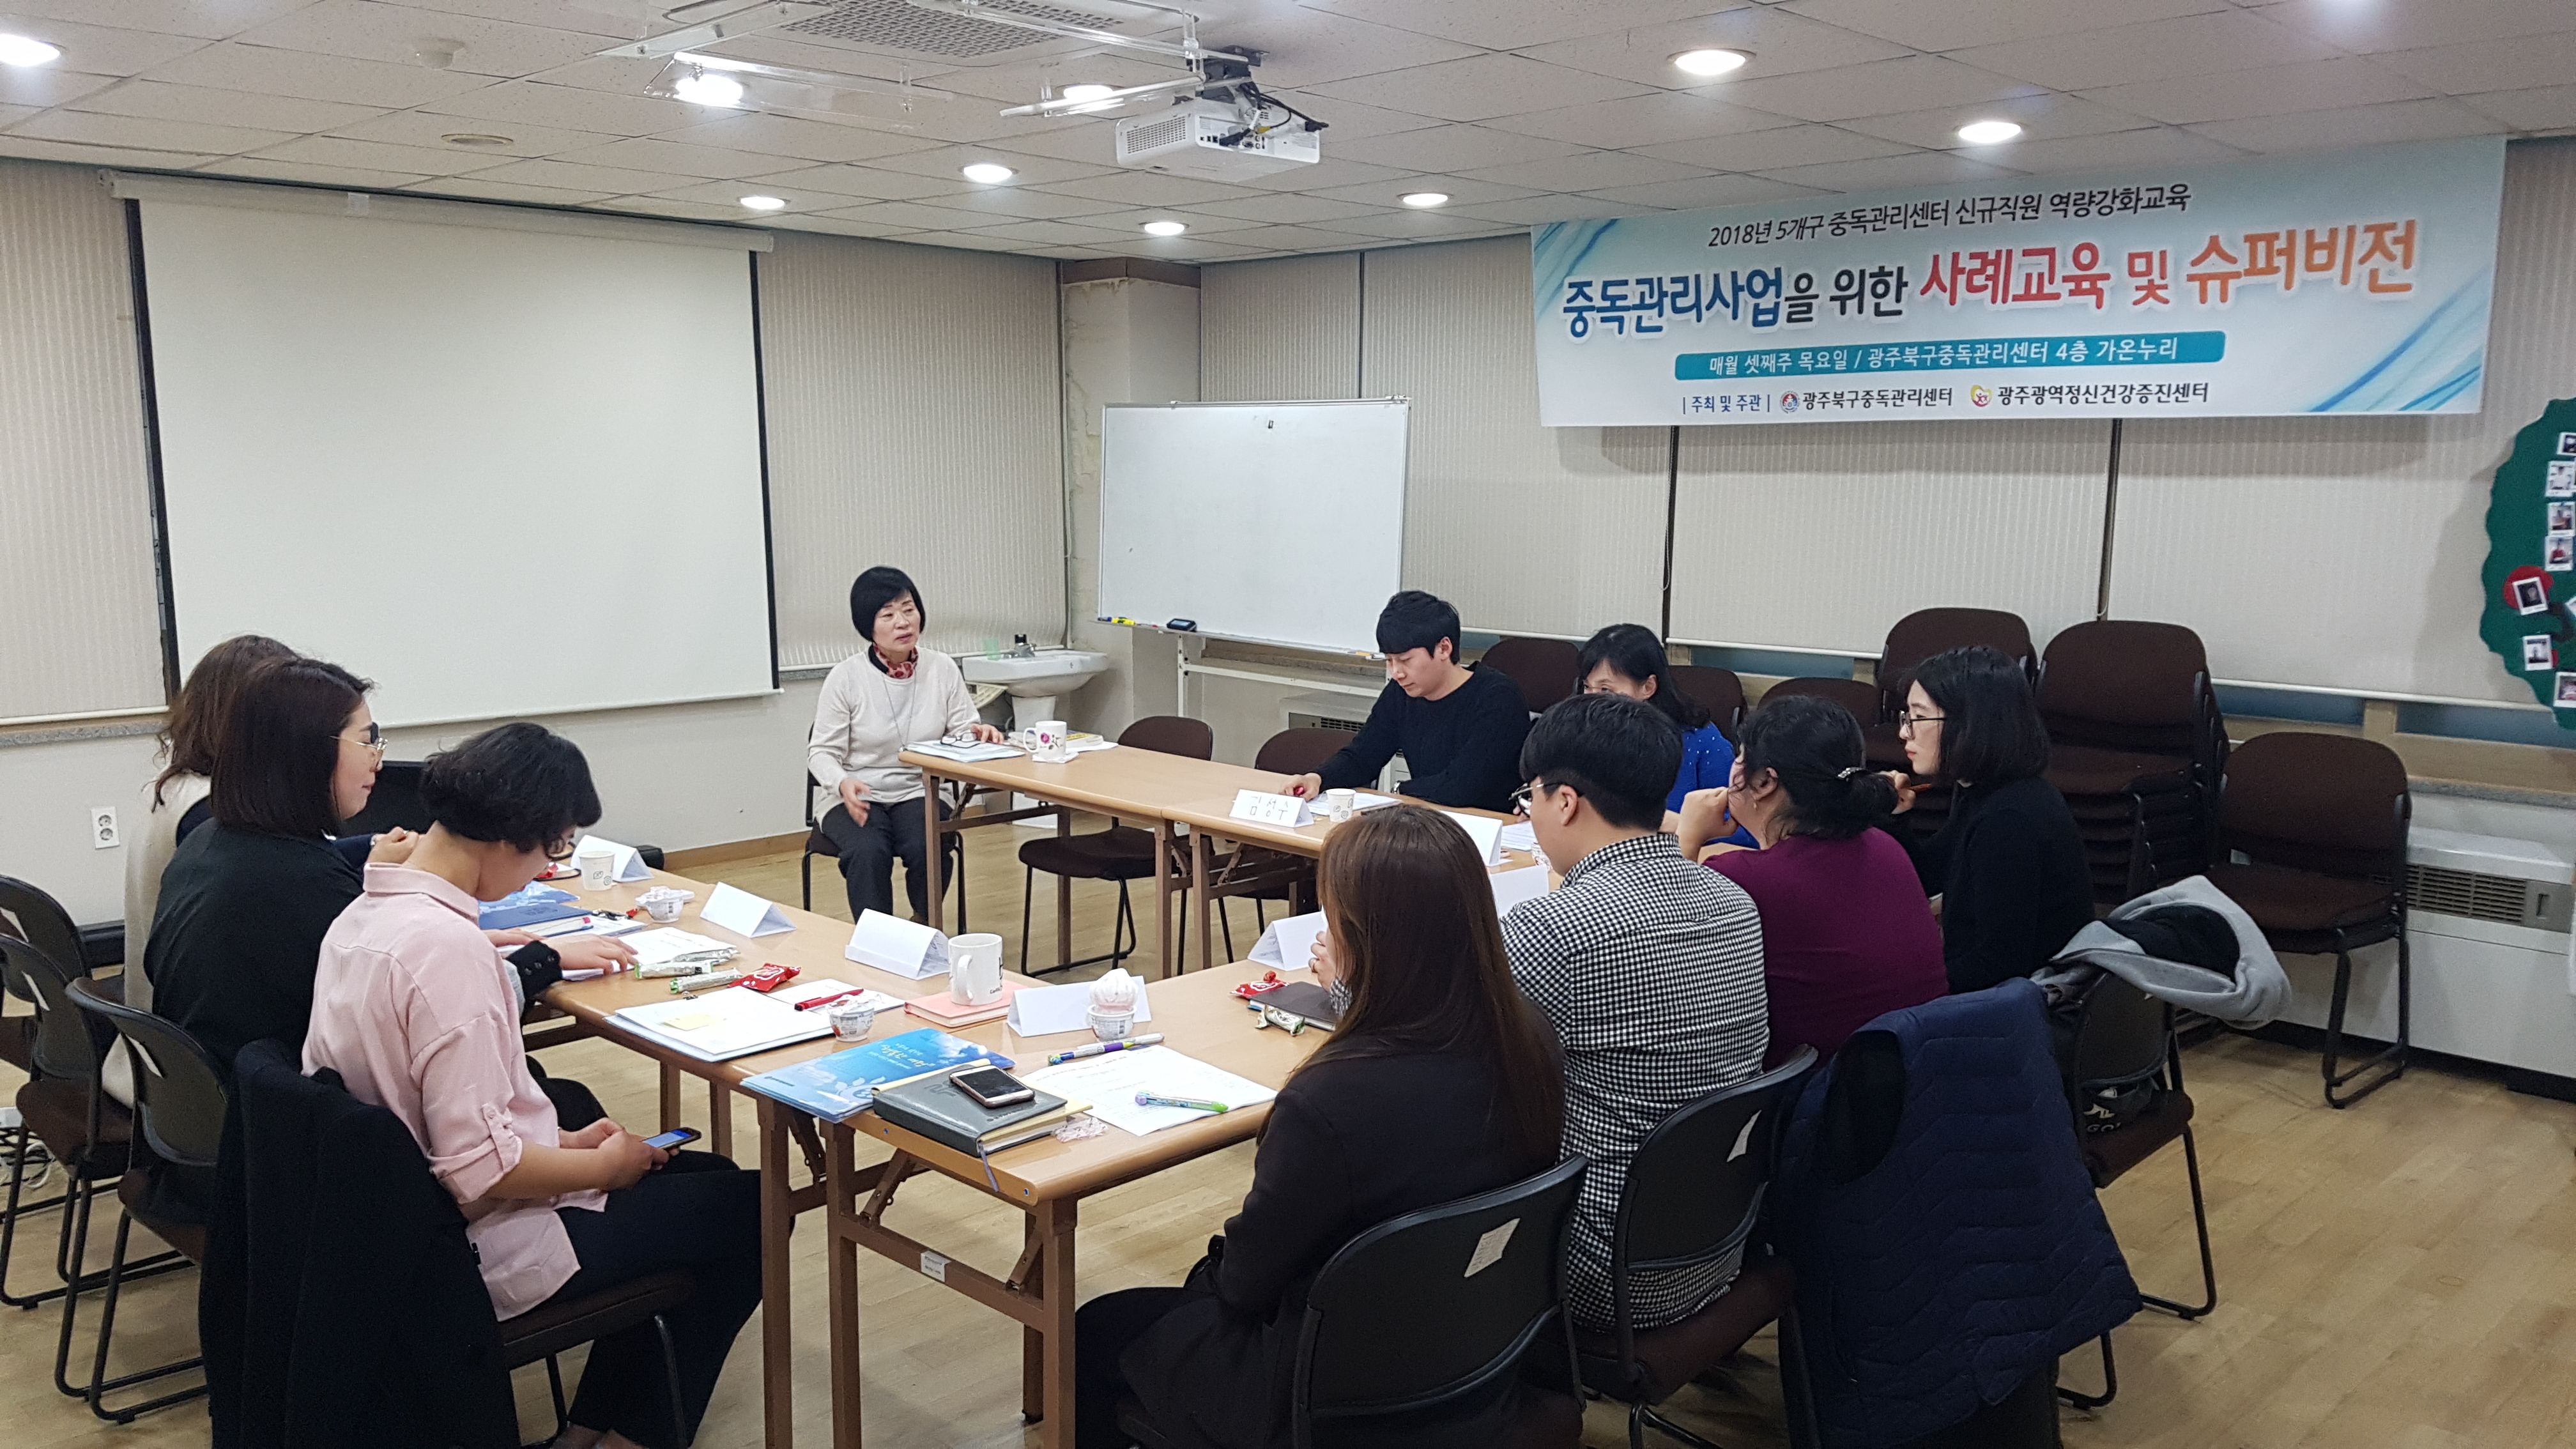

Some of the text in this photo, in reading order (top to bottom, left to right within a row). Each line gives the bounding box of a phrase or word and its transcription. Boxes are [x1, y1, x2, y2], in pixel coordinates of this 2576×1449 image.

[1708, 183, 2192, 247] 2018년 5개구 중독관리센터 신규직원 역량강화교육
[1563, 220, 2416, 338] 중독관리사업을 위한 사례교육 및 슈퍼비전
[1710, 355, 1738, 376] 매월
[1744, 353, 1793, 374] 셋째주
[1797, 349, 1848, 371] 목요일
[1867, 342, 2048, 369] 광주북구중독관리센터
[2055, 340, 2089, 362] 4층
[2096, 337, 2178, 362] 가온누리
[1691, 395, 1715, 413] 주최
[1720, 395, 1731, 413] 및
[1735, 394, 1761, 412] 주관
[1802, 387, 1952, 411] 광주북구중독관리센터
[1997, 382, 2209, 406] 광주광역정신건강증진센터
